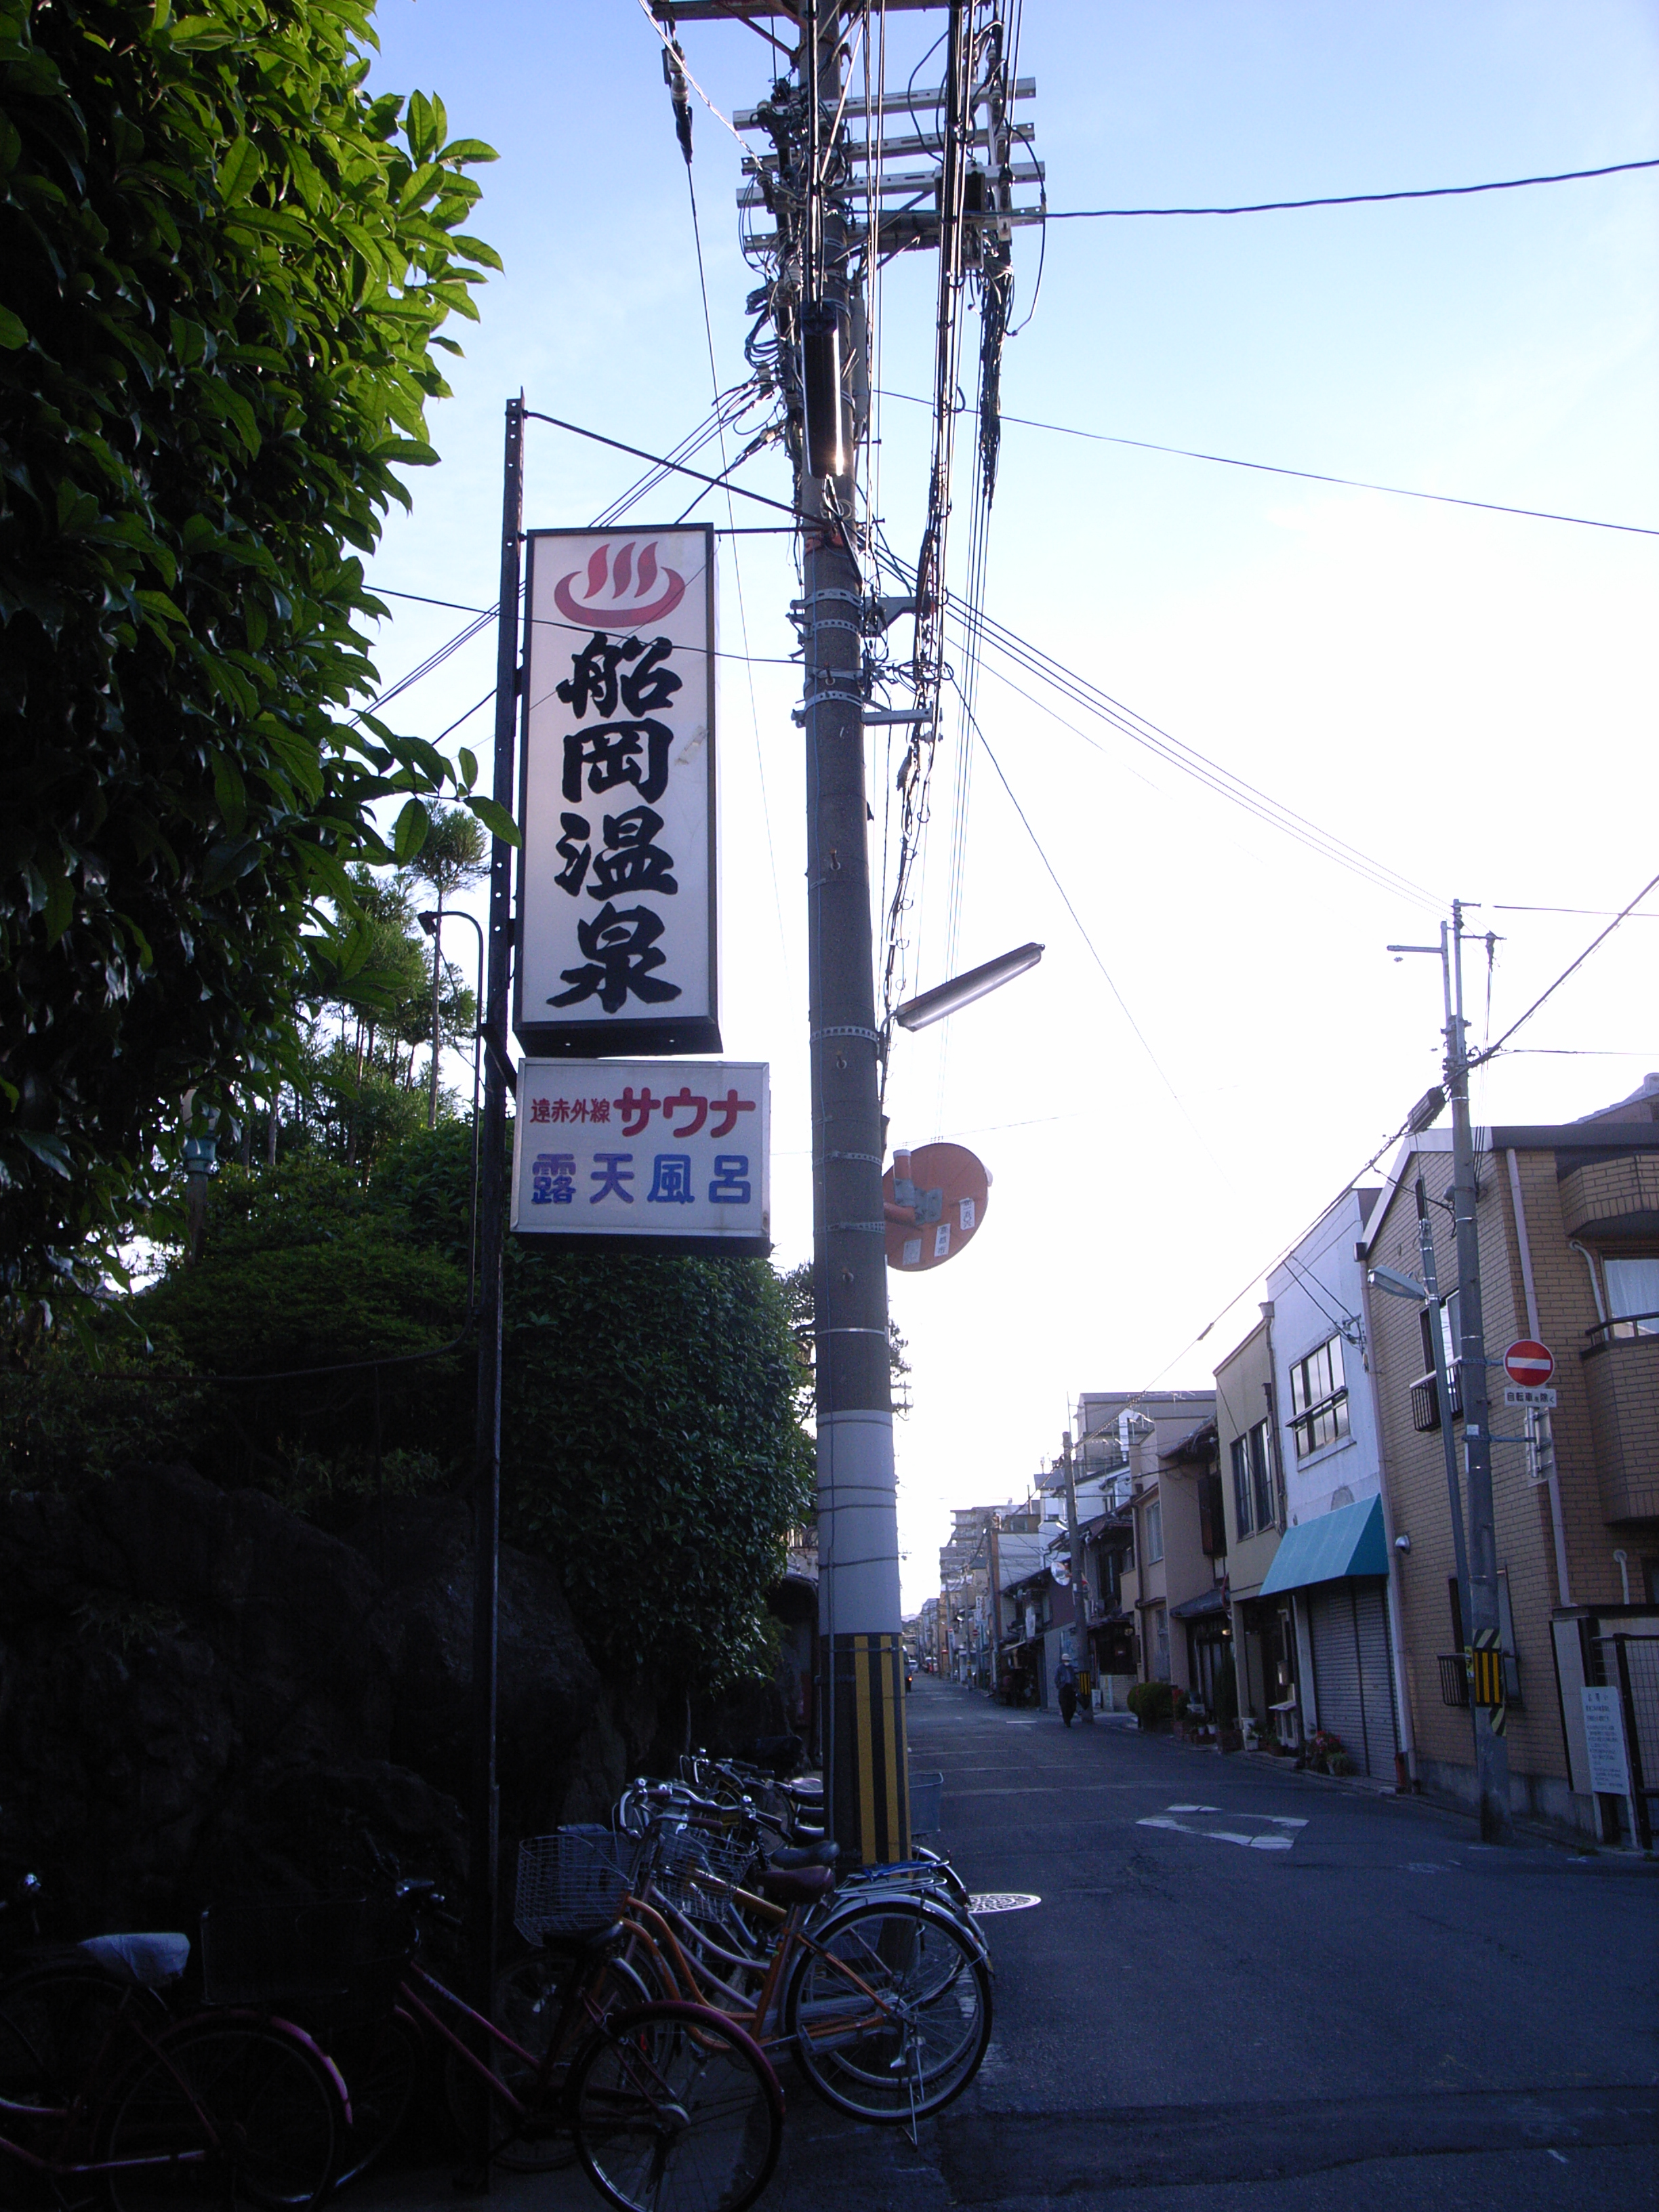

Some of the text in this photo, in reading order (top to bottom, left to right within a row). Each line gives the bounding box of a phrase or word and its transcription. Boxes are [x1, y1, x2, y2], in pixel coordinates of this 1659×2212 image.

[546, 631, 683, 1014] 船岡温泉
[531, 1153, 752, 1205] 露天風呂
[1507, 1391, 1555, 1404] 自転車を除く
